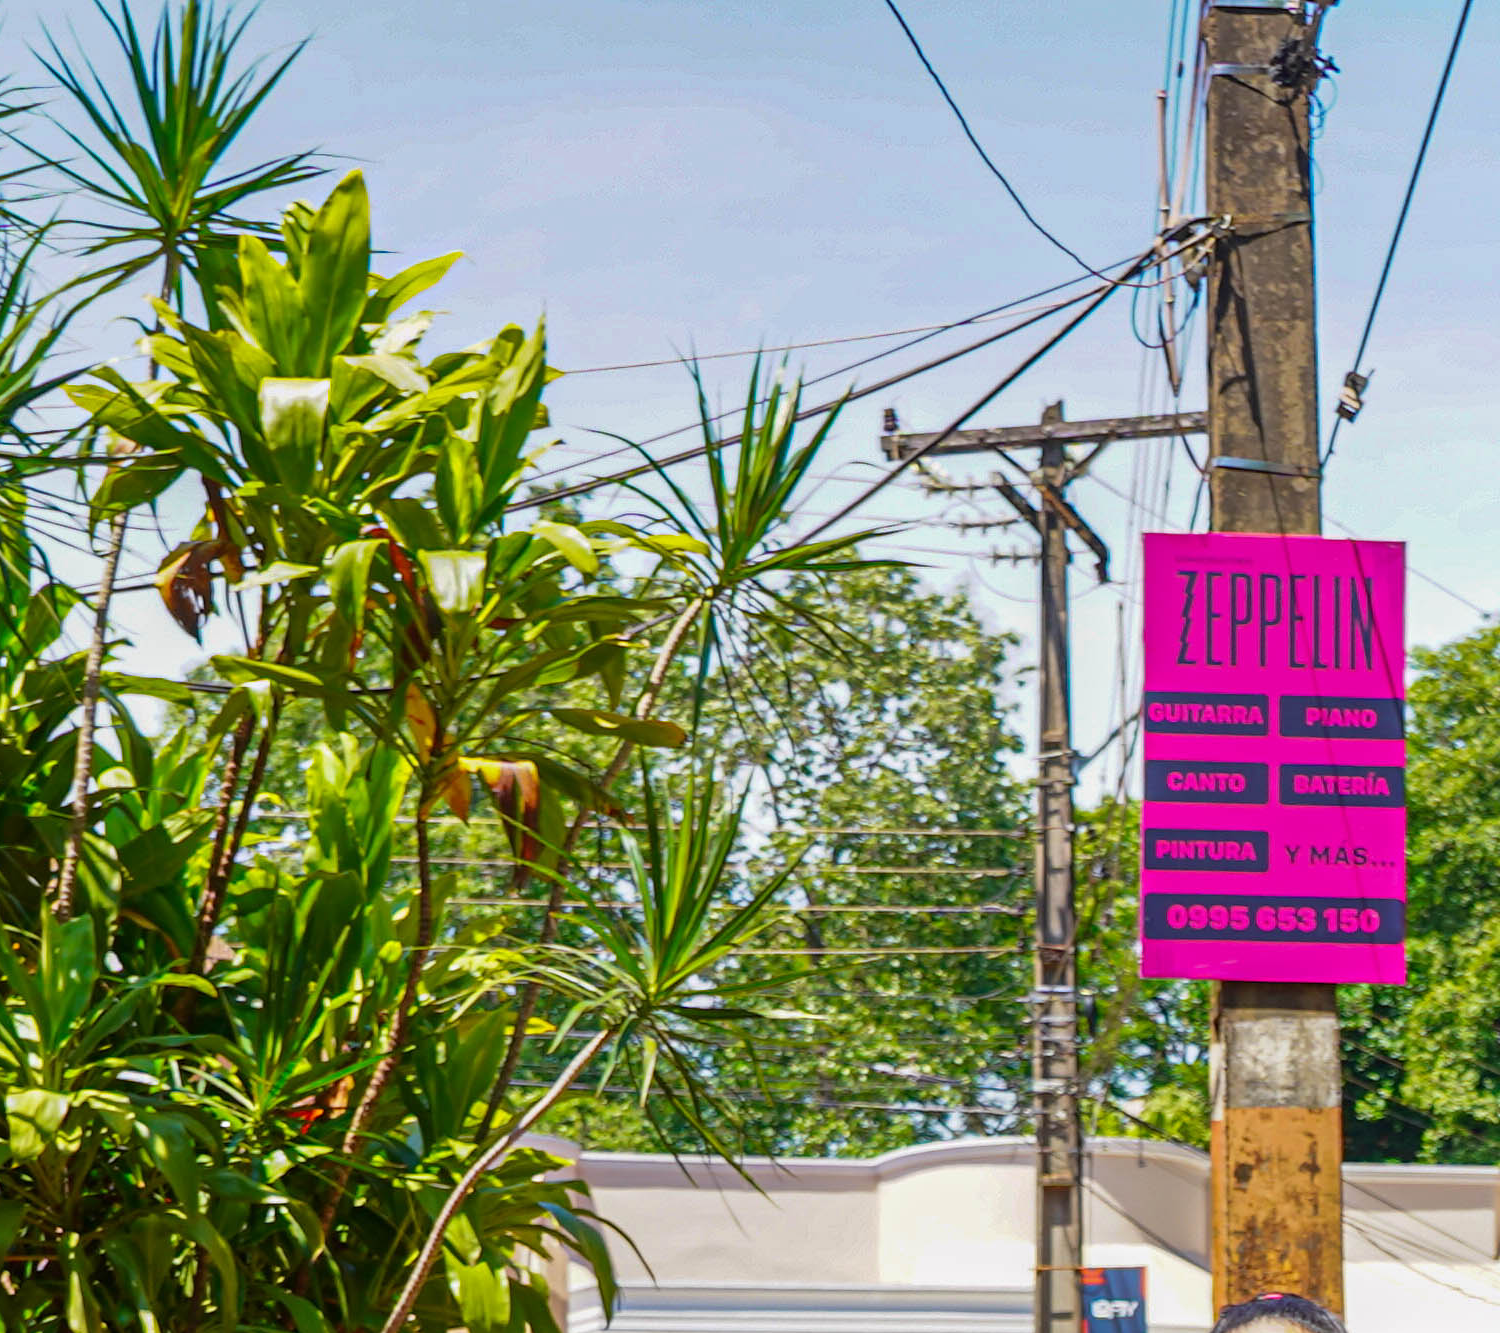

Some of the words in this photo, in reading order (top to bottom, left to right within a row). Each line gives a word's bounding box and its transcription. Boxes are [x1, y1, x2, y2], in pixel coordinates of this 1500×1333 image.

[1176, 570, 1373, 670] ZEPPELIN
[1148, 702, 1264, 726] GUITARRA
[1306, 707, 1378, 729] PIANO
[1166, 771, 1246, 793] CANTO
[1294, 771, 1390, 797] BATERÍA
[1155, 840, 1257, 862] PINTURA
[1285, 845, 1301, 865] Y
[1166, 904, 1249, 932] 0995
[1256, 906, 1316, 933] 653
[1323, 907, 1381, 935] 150
